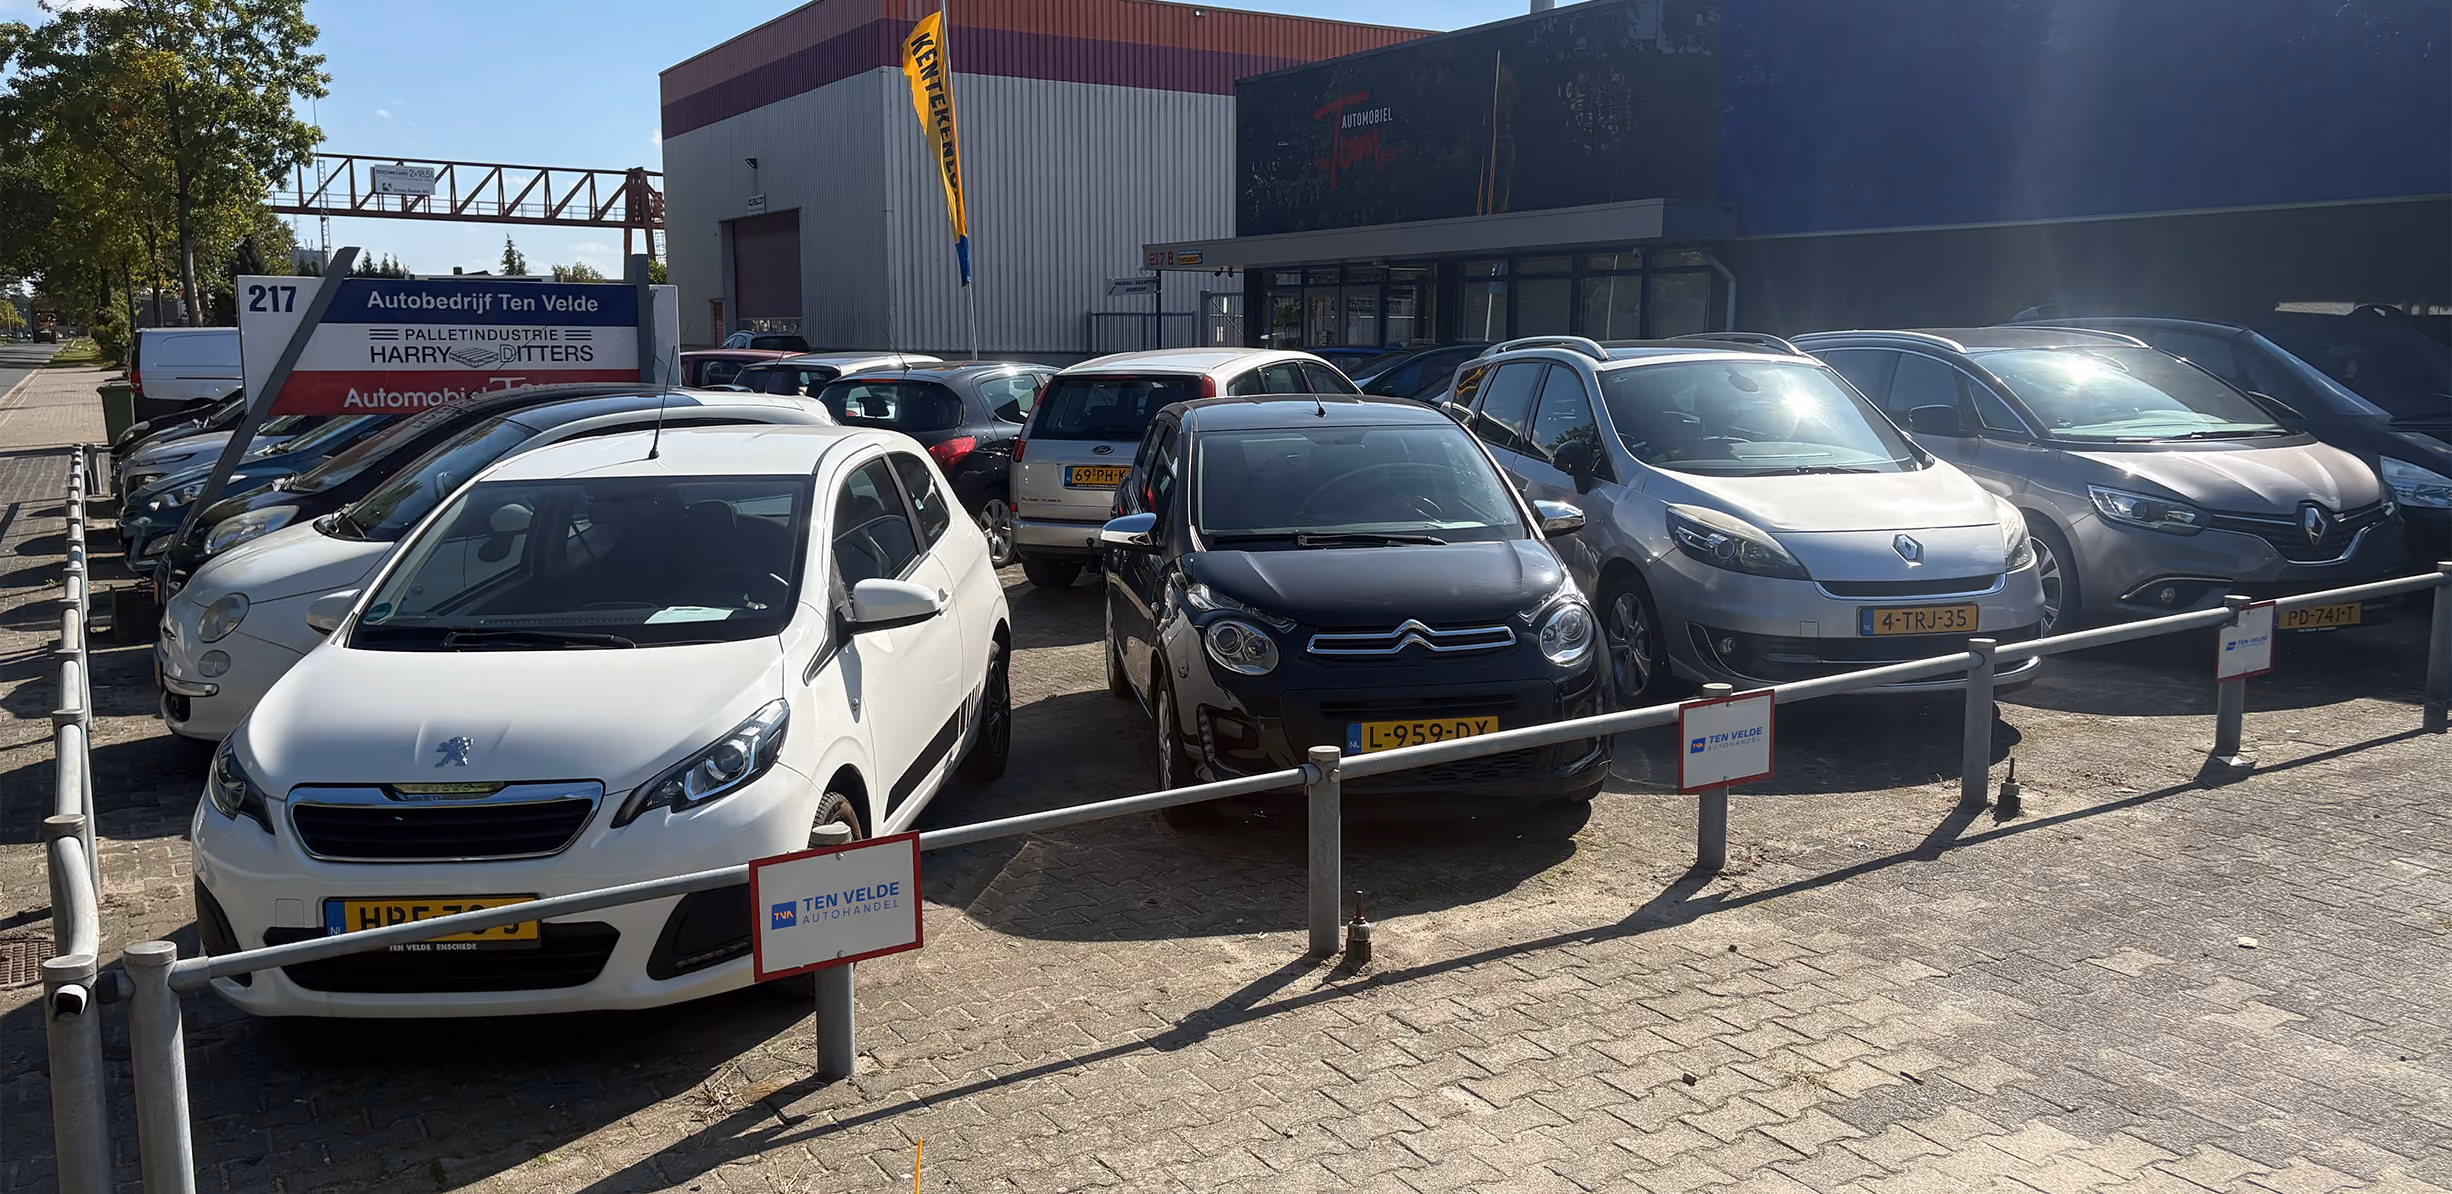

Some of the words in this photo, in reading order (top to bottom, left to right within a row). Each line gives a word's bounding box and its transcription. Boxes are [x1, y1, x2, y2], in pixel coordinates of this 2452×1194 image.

[1341, 107, 1392, 128] AUTOMOBIEL
[1149, 252, 1165, 266] 217
[1168, 251, 1174, 266] B
[248, 285, 297, 313] 217
[367, 291, 492, 314] Autobedrijf
[498, 294, 535, 311] Ten
[541, 295, 599, 312] Velde
[405, 328, 558, 341] PALLETINDUSTRIE
[370, 345, 451, 364] HARRY
[500, 344, 594, 363] DITTERS
[343, 386, 488, 408] Automobi
[1882, 609, 1967, 631] 4-TRJ-35
[2288, 606, 2355, 626] PD-741-T
[1350, 740, 1360, 748] NL
[1707, 736, 1760, 752] AUTOHANDEL
[1709, 732, 1729, 744] TEN
[1731, 726, 1763, 740] VELDE
[802, 893, 837, 912] TEN
[843, 881, 900, 905] VELDE
[802, 899, 900, 925] AUTOHANDEL
